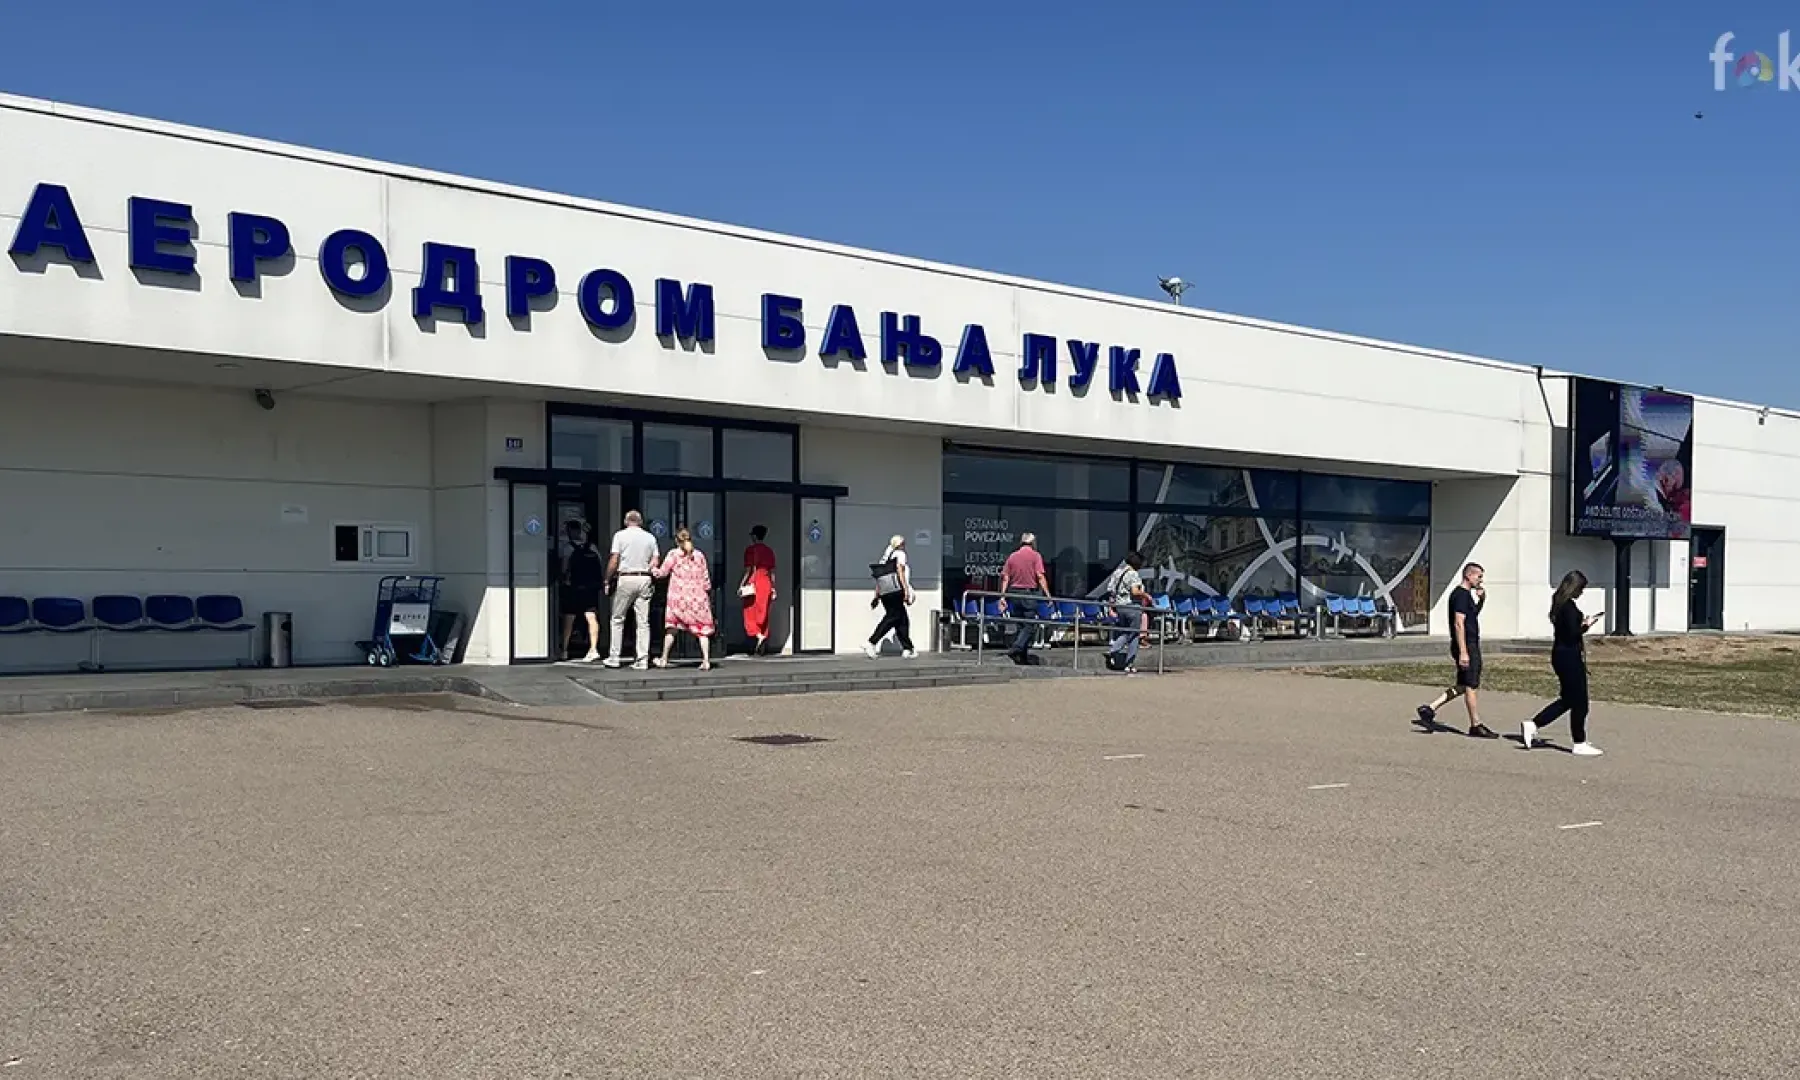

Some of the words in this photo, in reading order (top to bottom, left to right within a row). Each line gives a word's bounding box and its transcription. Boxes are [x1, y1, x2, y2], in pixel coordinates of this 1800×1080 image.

[8, 182, 715, 343] АЕРОДРОМ
[761, 292, 996, 377] БАЊА
[1018, 332, 1183, 400] ЛУКА
[989, 551, 1004, 564] STA
[964, 565, 1004, 577] CONNEC
